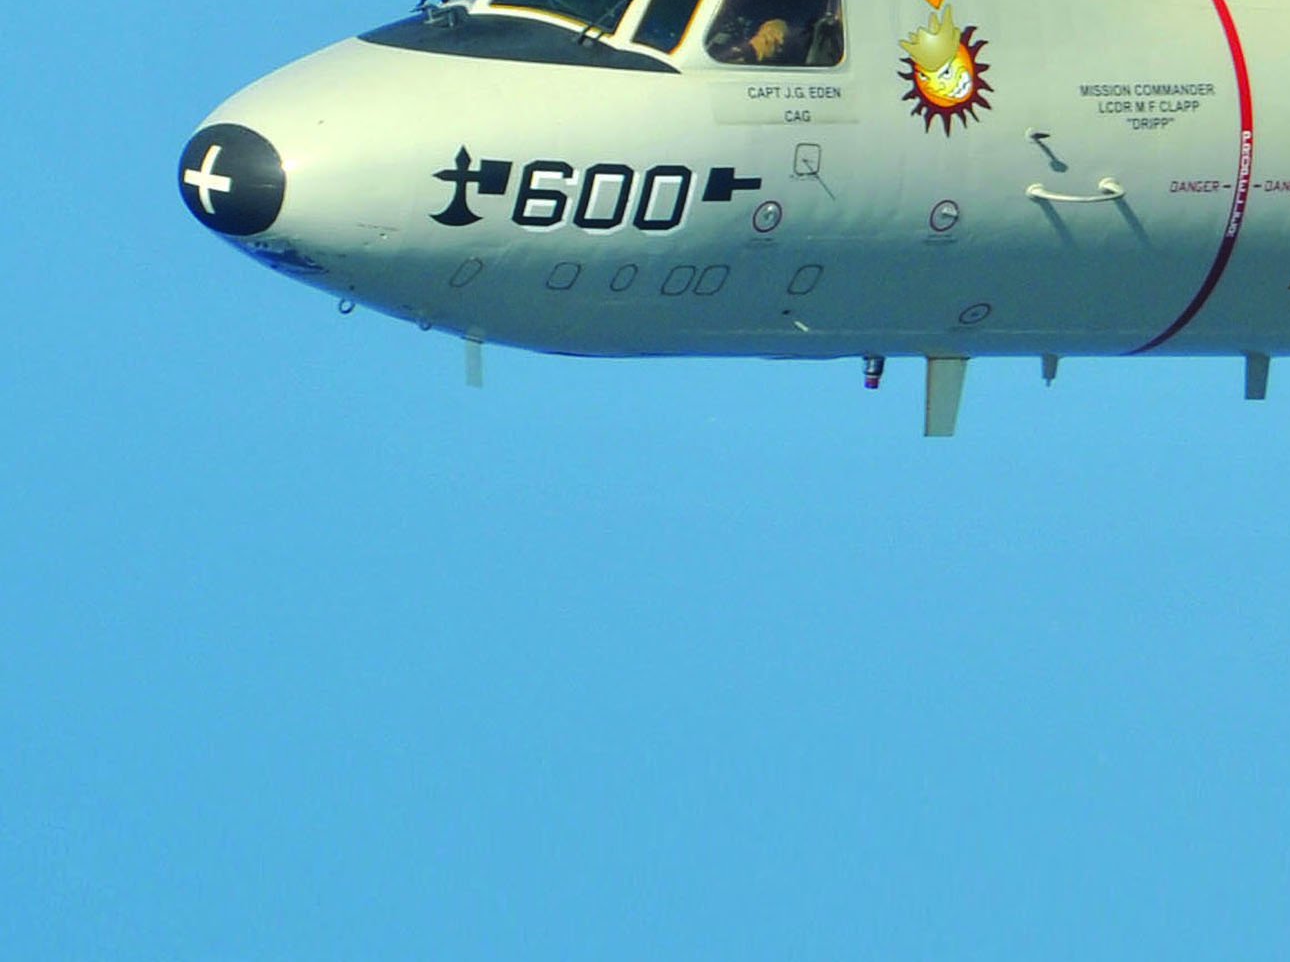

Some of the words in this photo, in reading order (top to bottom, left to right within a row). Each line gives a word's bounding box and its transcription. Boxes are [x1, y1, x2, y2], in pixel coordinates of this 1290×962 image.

[747, 86, 781, 99] CAPT
[808, 86, 842, 99] EDEN
[1080, 84, 1132, 97] MISSION
[1134, 83, 1216, 96] COMMANDER
[1098, 101, 1132, 113] LCDR
[1135, 101, 1145, 113] M
[1148, 101, 1156, 113] F
[1159, 100, 1200, 113] CLAPP
[784, 109, 812, 123] CAG
[1170, 181, 1220, 193] DANGER
[511, 159, 697, 236] 600
